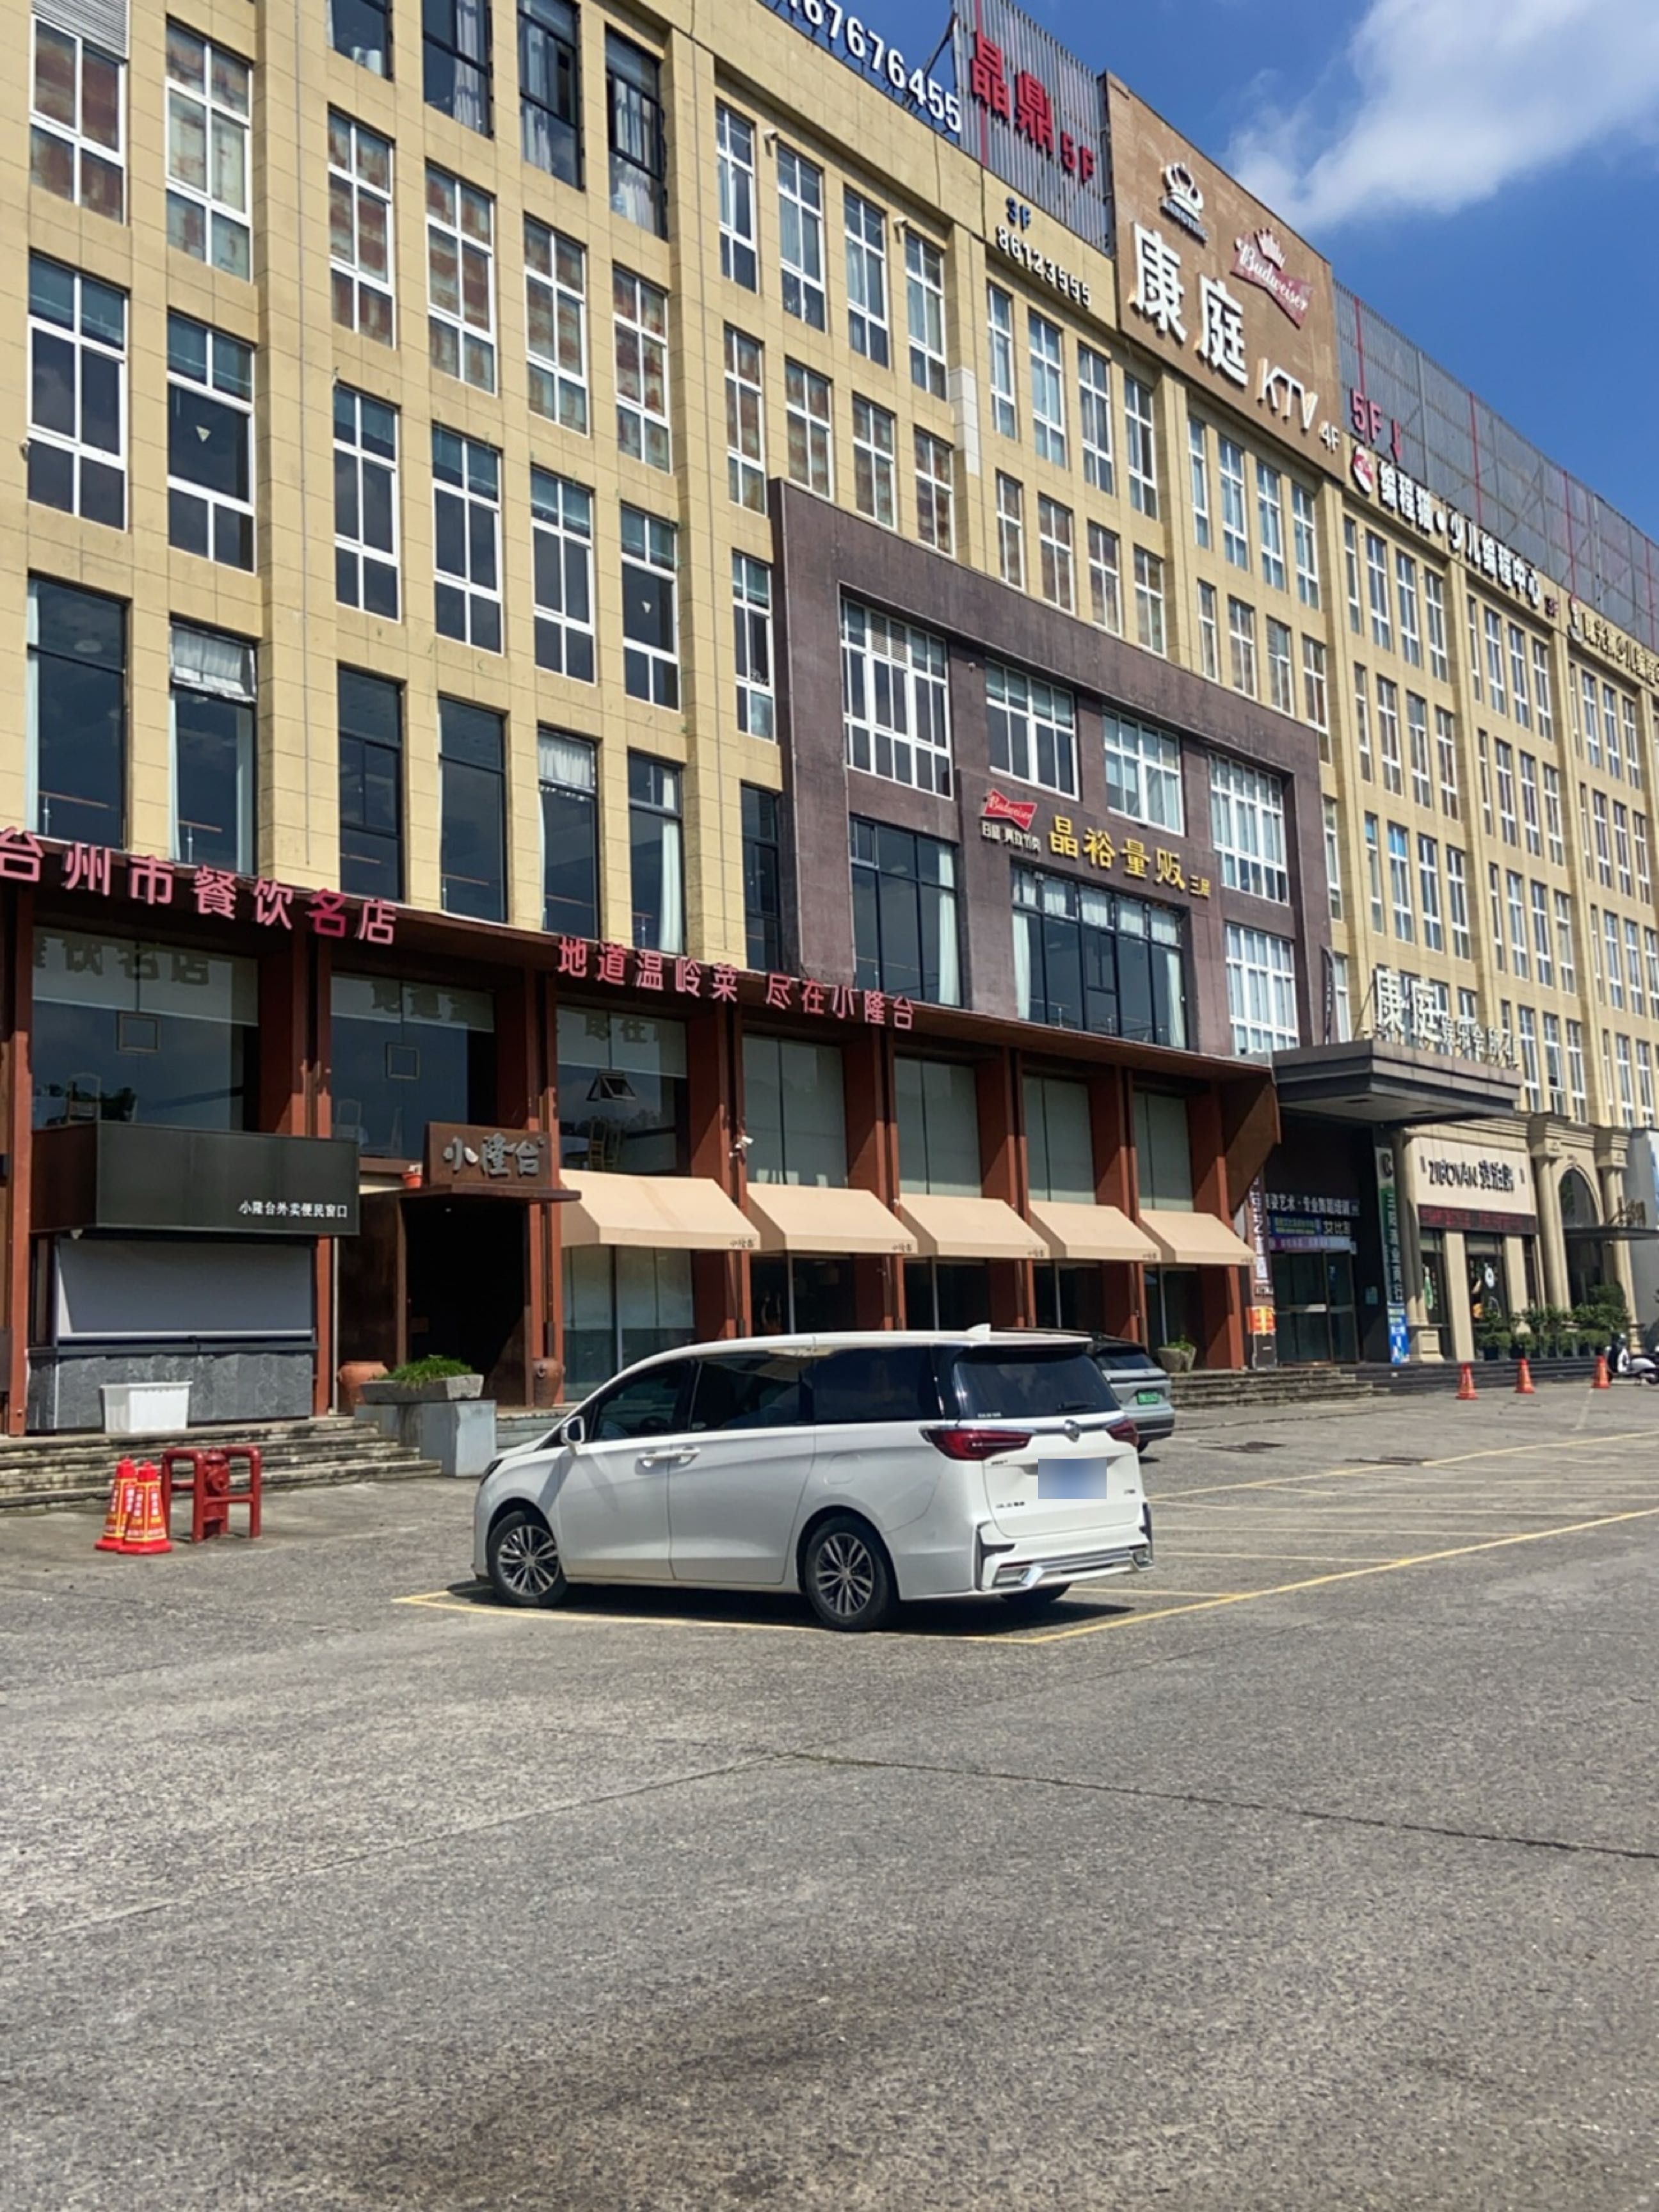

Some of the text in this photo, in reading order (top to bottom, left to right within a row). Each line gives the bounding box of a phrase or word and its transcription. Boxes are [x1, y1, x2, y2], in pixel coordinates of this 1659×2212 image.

[789, 0, 961, 133] 67676455
[971, 31, 1095, 183] 晶鼎 5F
[997, 225, 1091, 308] 86123555
[1235, 237, 1308, 311] Budweiser
[1133, 221, 1249, 386] 康庭
[1257, 358, 1318, 429] KTV
[1350, 389, 1382, 442] 5F
[0, 825, 396, 945] 台州市餐饮名店
[1050, 815, 1186, 891] 晶裕量贩
[557, 935, 913, 1030] 地道温岭菜 尽在小隆台
[1375, 968, 1443, 1042] 康庭
[442, 1132, 545, 1175] 小隆台
[237, 1199, 348, 1218] 小隆台外卖便民窗口
